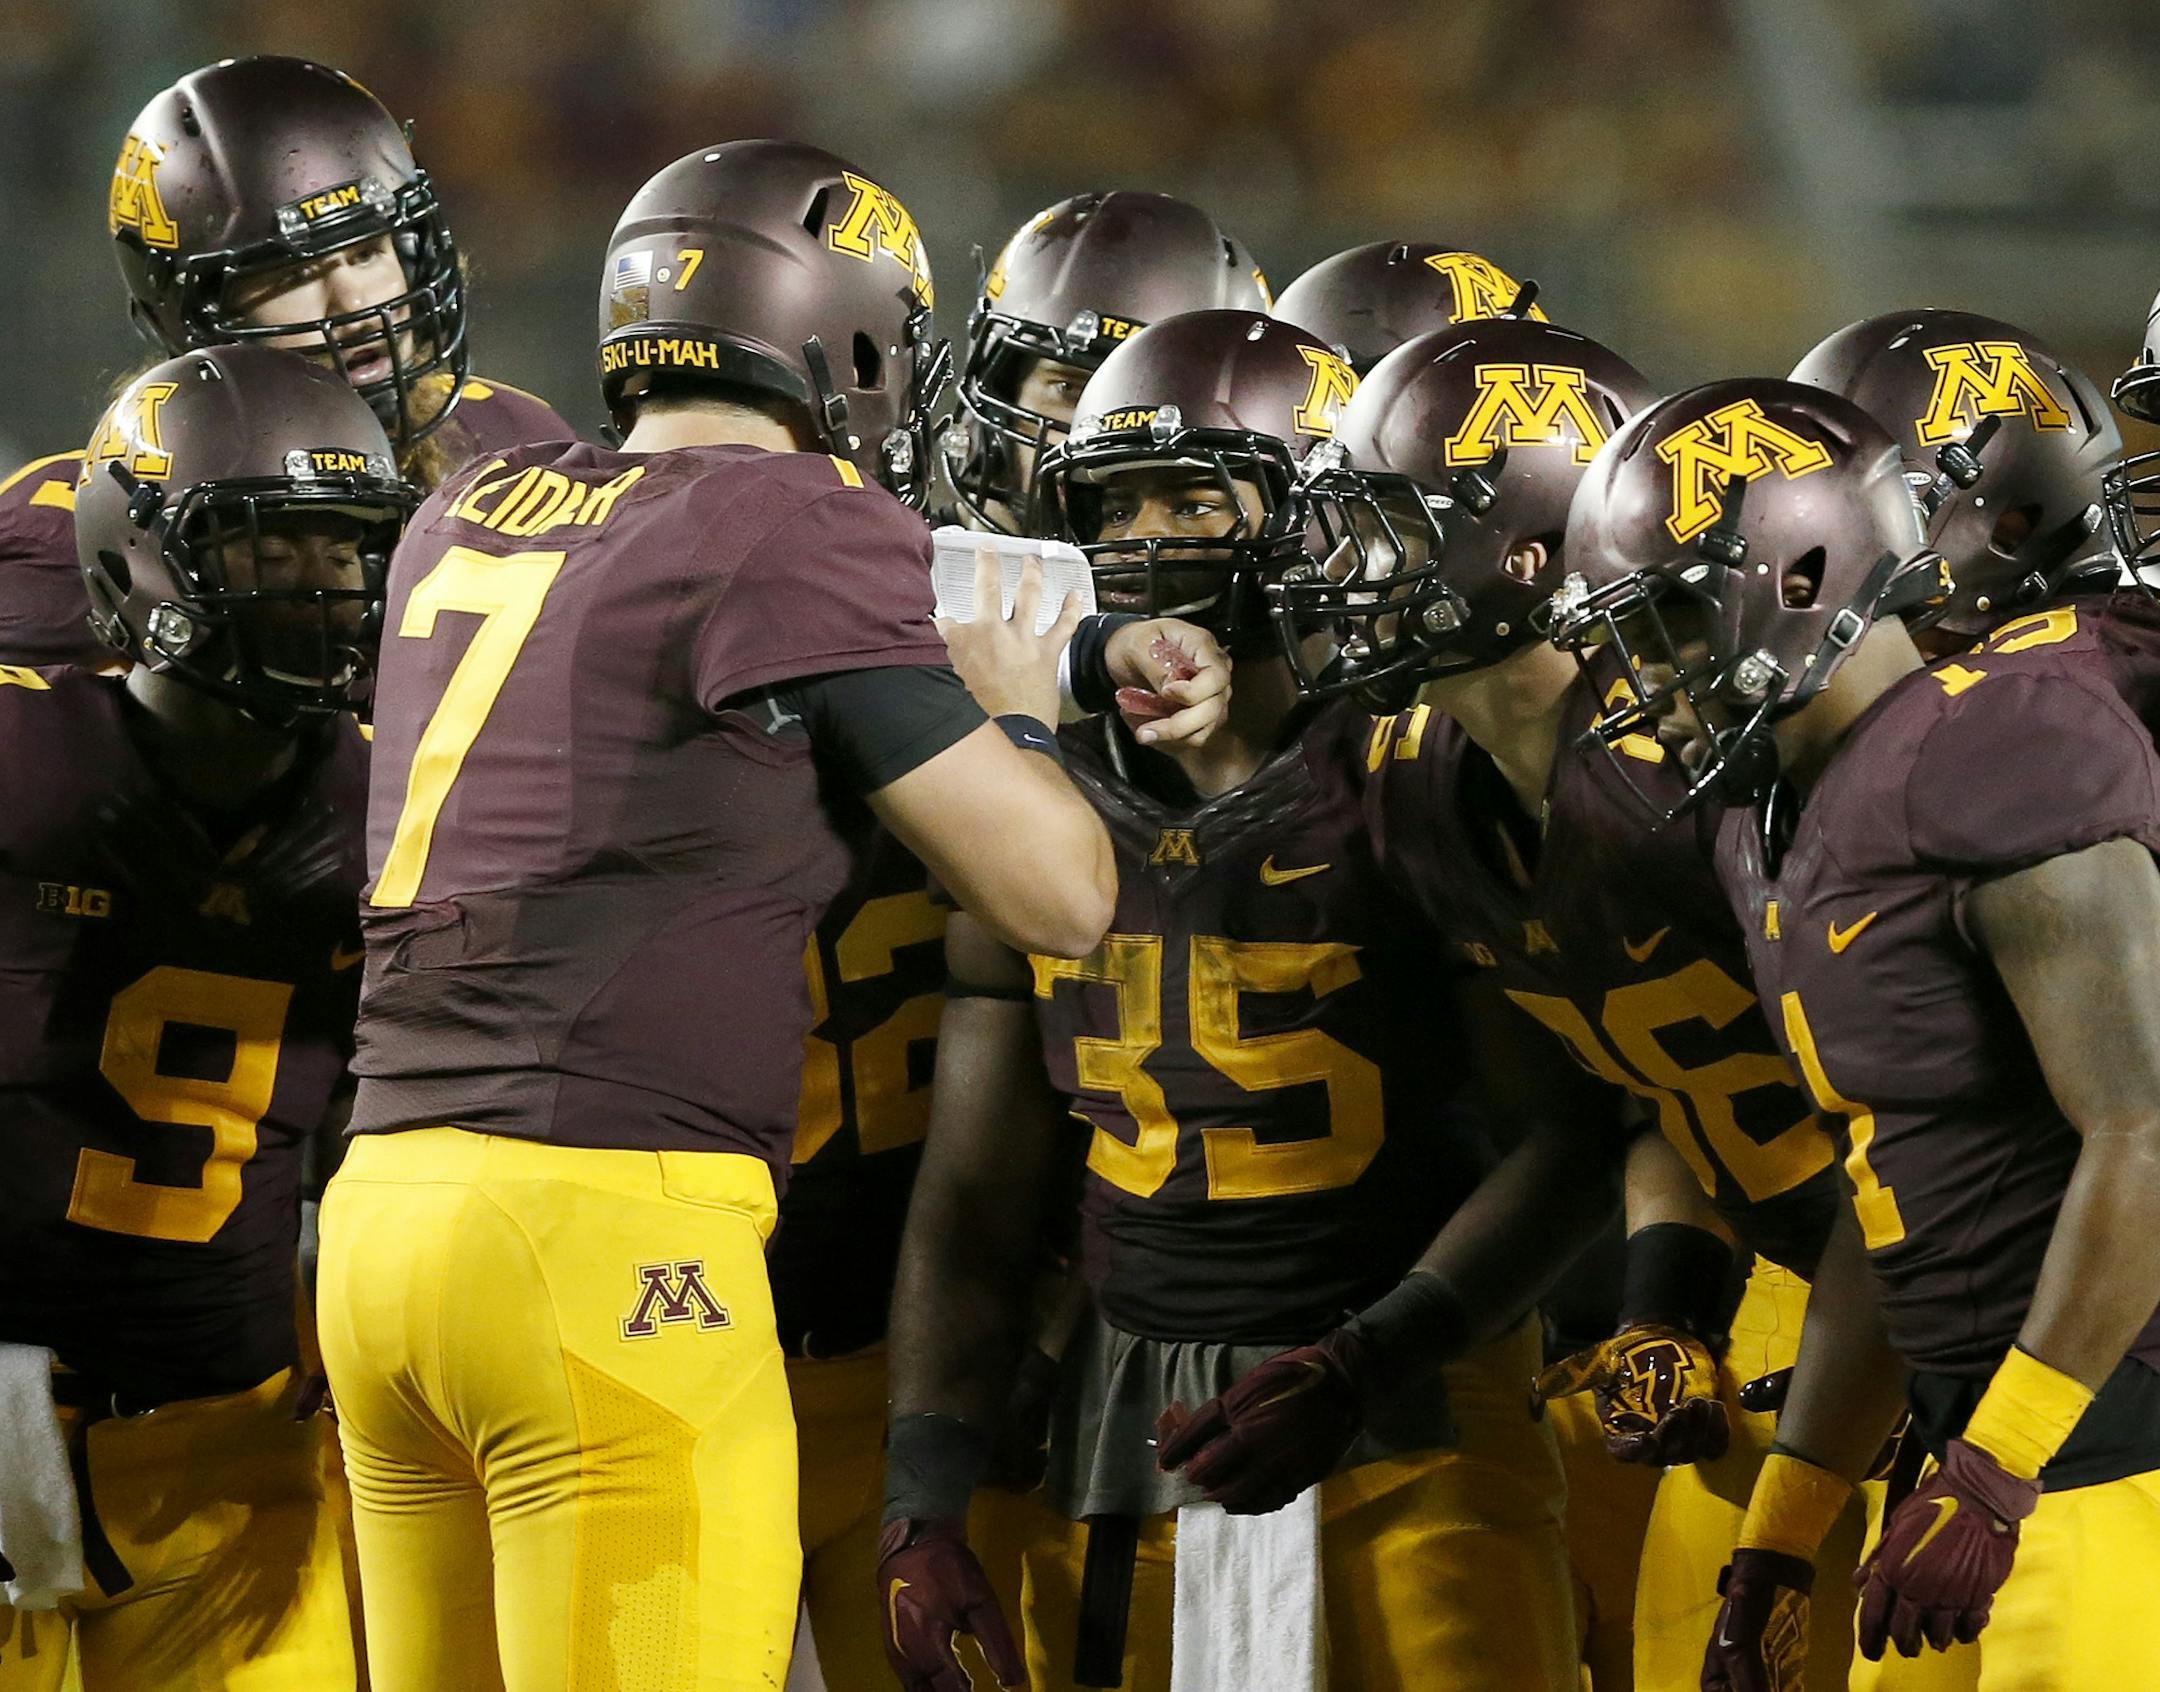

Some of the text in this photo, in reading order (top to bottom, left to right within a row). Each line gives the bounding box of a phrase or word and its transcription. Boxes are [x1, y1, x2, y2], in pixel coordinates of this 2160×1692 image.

[300, 185, 360, 221] TEAM
[674, 248, 705, 292] 7
[601, 339, 720, 373] SKI-U-MAH
[1914, 340, 2073, 448] M
[310, 451, 366, 473] TEAM
[1102, 410, 1157, 430] TEAM
[1443, 362, 1610, 468] M
[1654, 397, 1835, 545] M
[368, 544, 567, 907] 7
[1148, 827, 1201, 866] M
[66, 965, 295, 1243] 9
[1027, 933, 1386, 1201] 35
[1504, 957, 1838, 1204] 16
[1781, 990, 1905, 1252] 1
[618, 1256, 735, 1343] M
